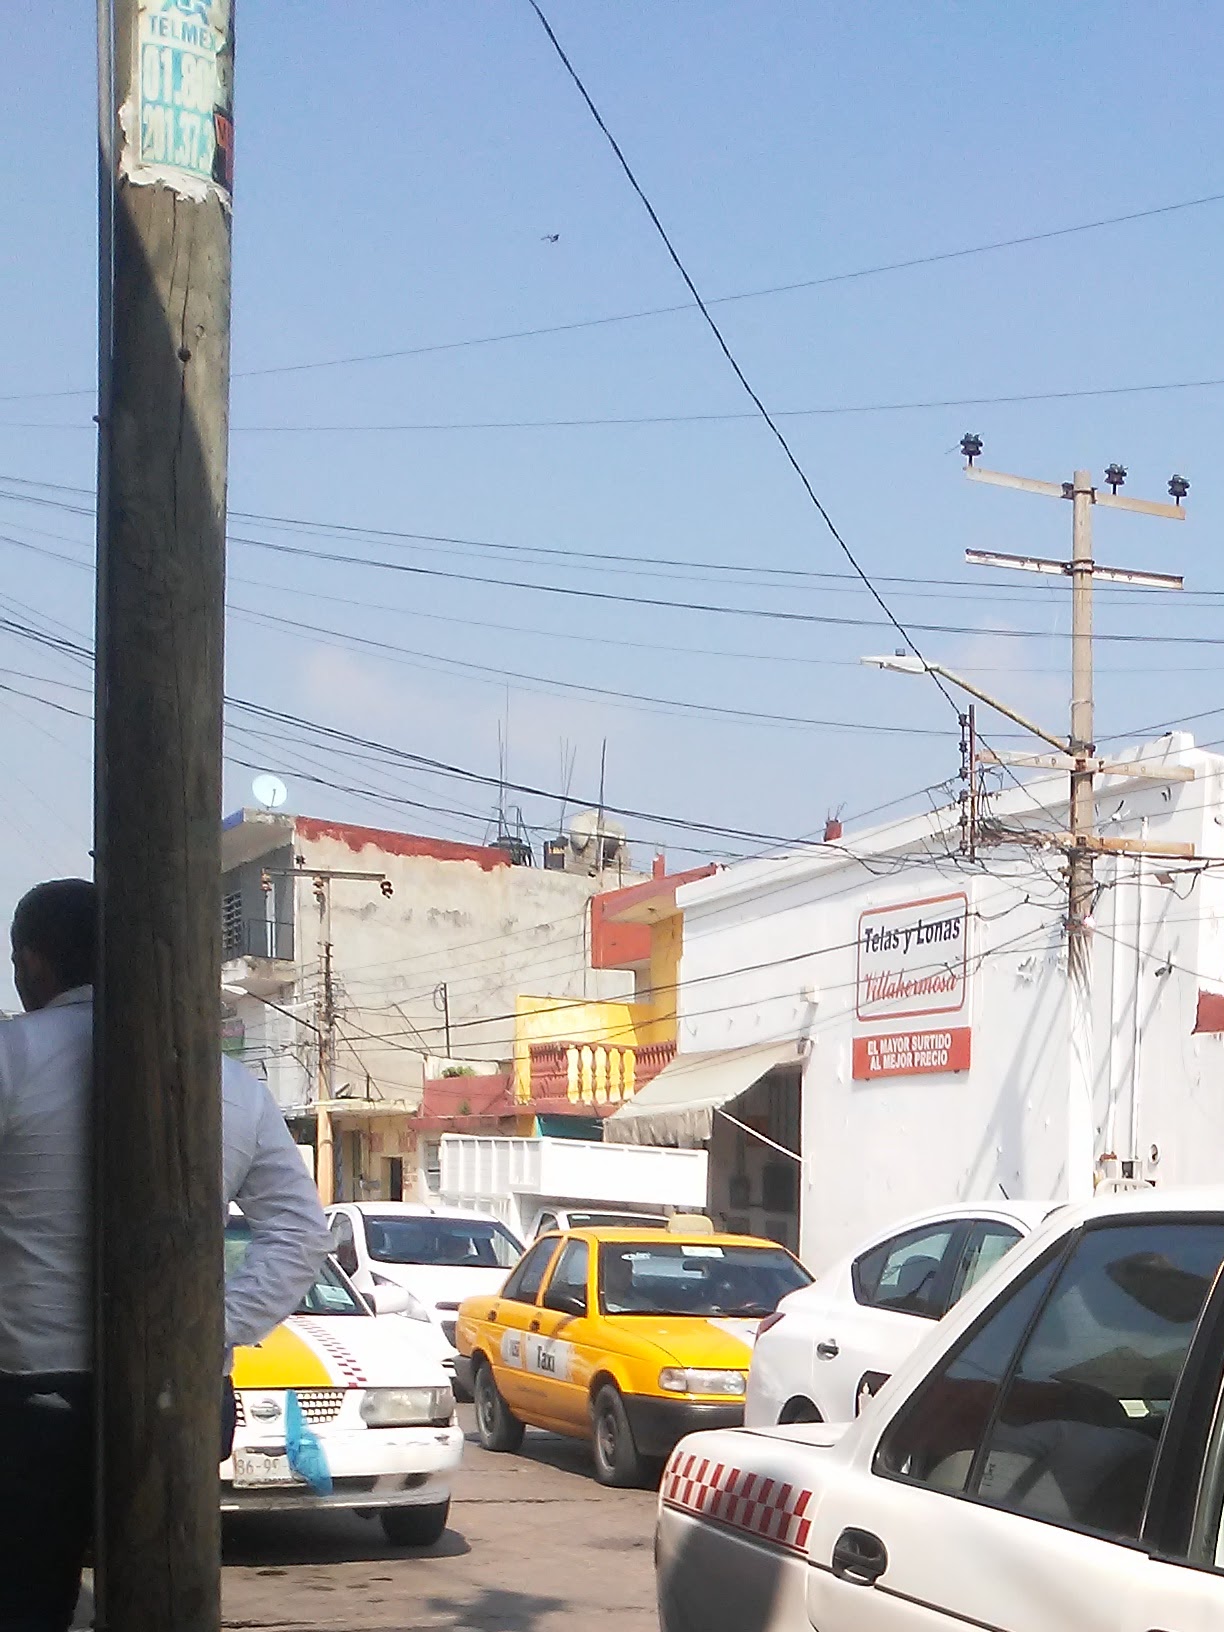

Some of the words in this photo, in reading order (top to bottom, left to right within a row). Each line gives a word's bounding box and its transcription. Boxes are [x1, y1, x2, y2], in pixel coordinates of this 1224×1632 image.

[864, 926, 900, 953] Telas
[903, 928, 912, 954] y
[916, 917, 960, 945] Lonas
[864, 968, 957, 1002] Villahermosa
[867, 1040, 879, 1056] EL
[880, 1036, 910, 1054] MAYOR
[911, 1033, 952, 1051] SURTIDO
[870, 1055, 881, 1071] AL
[883, 1052, 913, 1069] MEJOR
[914, 1050, 948, 1067] PRECIO
